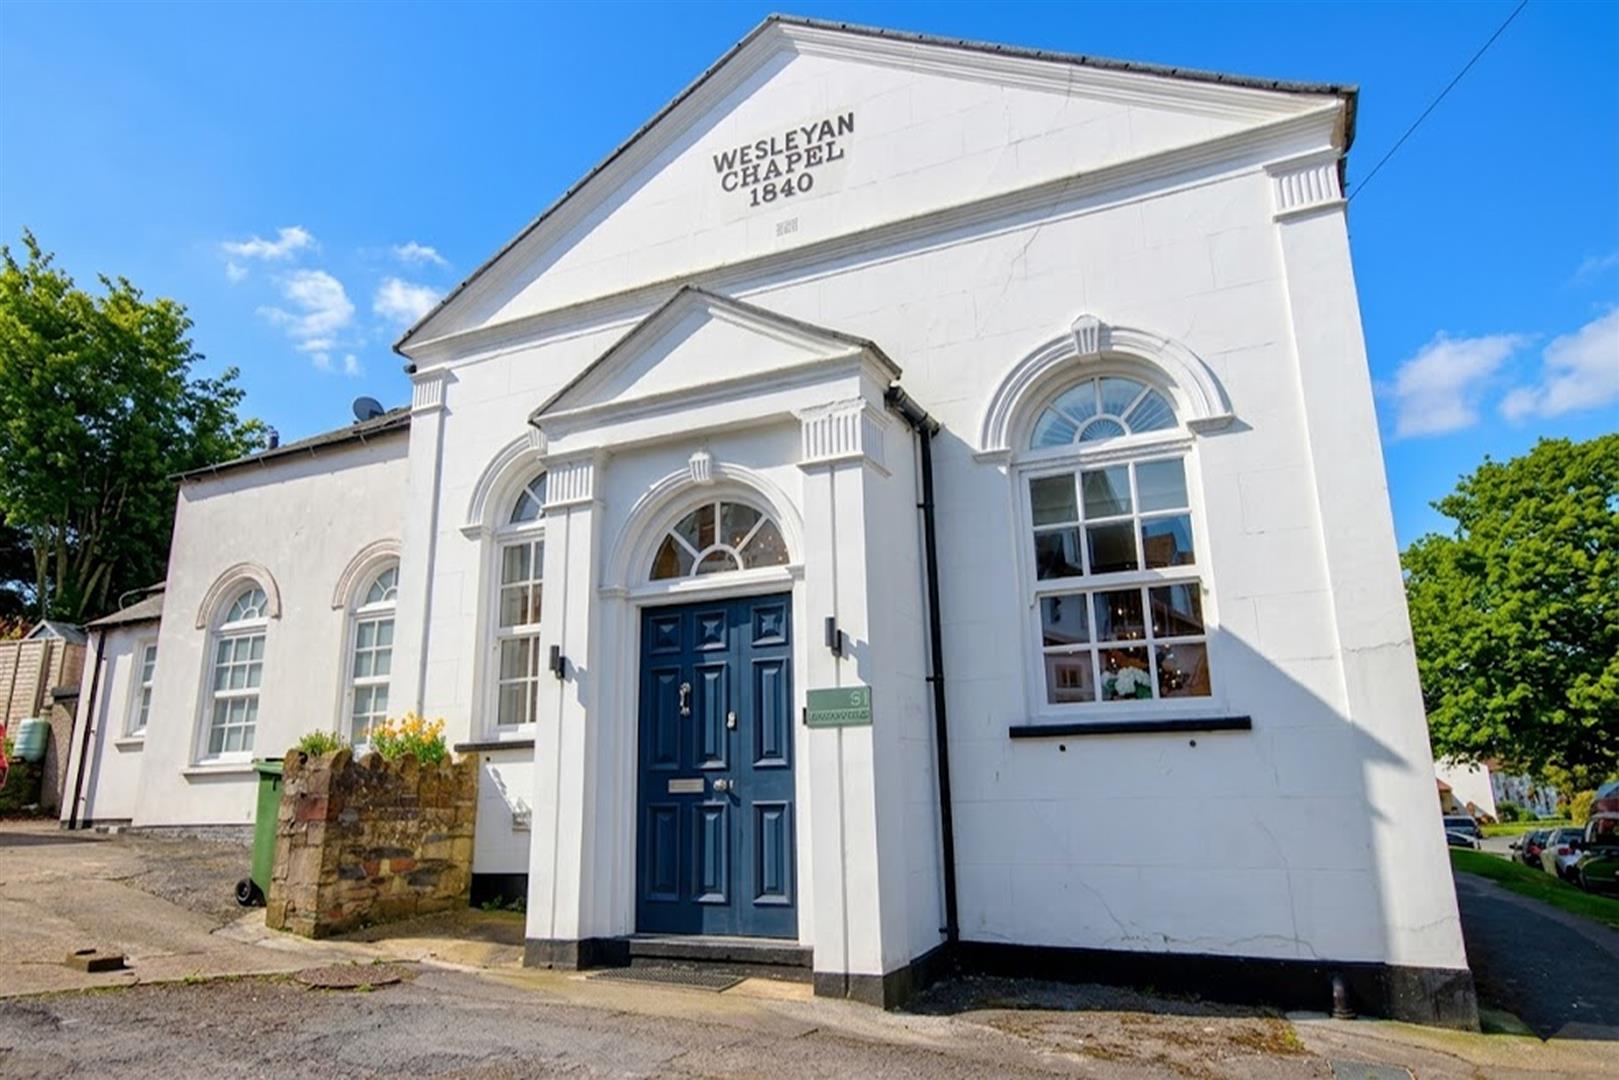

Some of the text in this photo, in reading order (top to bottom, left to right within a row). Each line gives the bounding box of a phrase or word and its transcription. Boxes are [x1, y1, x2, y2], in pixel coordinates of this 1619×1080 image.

[713, 112, 854, 173] WESLEYAN
[721, 141, 844, 192] CHAPEL
[750, 173, 814, 207] 1840
